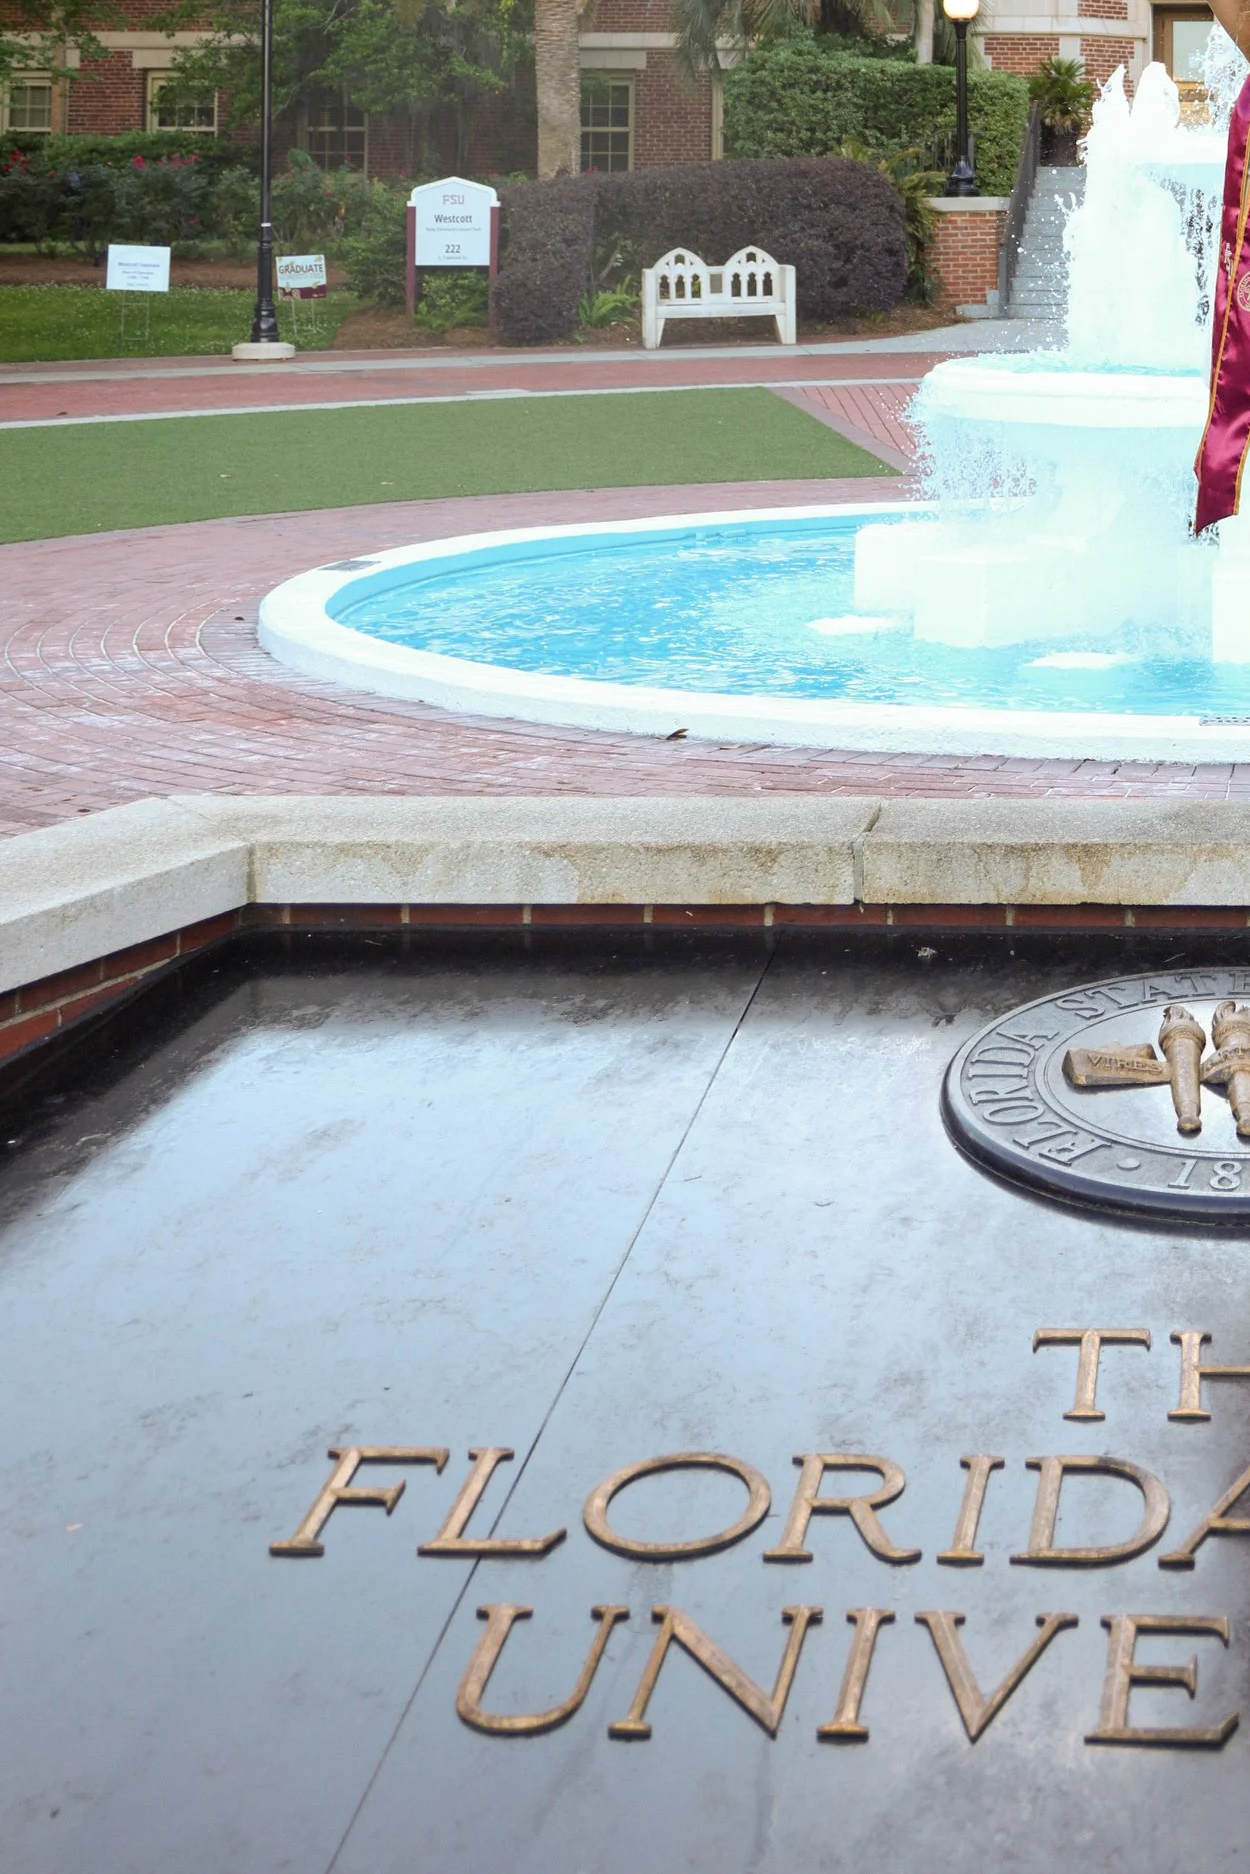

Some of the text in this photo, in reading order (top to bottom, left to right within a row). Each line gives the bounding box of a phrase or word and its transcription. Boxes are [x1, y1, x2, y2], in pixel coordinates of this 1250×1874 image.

[442, 194, 465, 205] FSU
[434, 214, 473, 223] Westcott
[445, 244, 461, 254] 222
[278, 263, 324, 274] GRADUATE
[1086, 1052, 1163, 1075] VIRES
[968, 1030, 1113, 1167] FLORIDA
